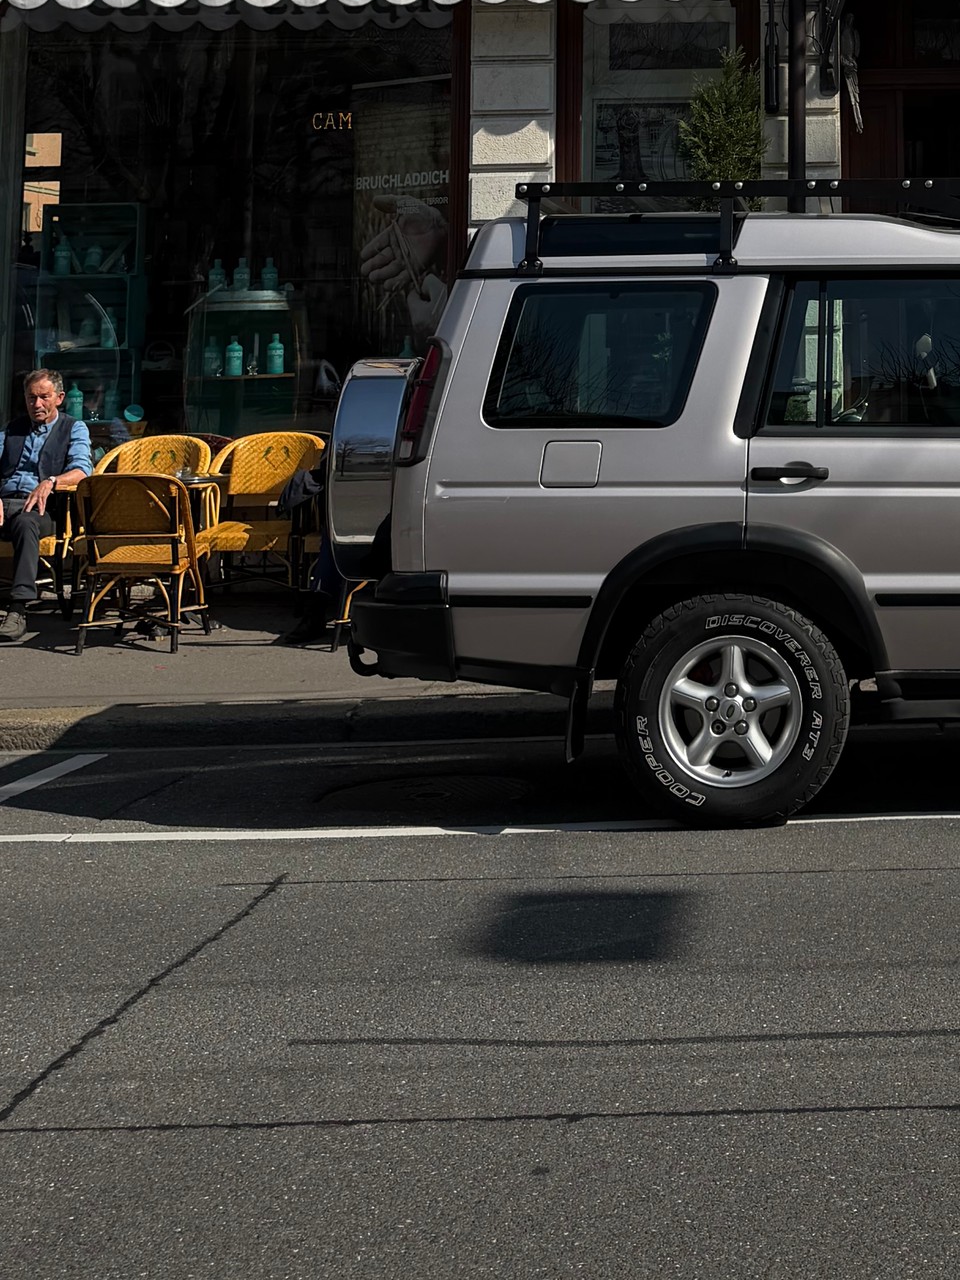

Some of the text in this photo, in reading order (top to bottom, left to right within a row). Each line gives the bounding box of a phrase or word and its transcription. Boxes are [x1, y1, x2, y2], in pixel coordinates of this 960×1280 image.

[312, 112, 353, 130] CAM
[355, 169, 450, 191] BRUICHLADDICH
[705, 613, 824, 762] DISCOVERER AT3
[635, 715, 707, 808] COOPER
